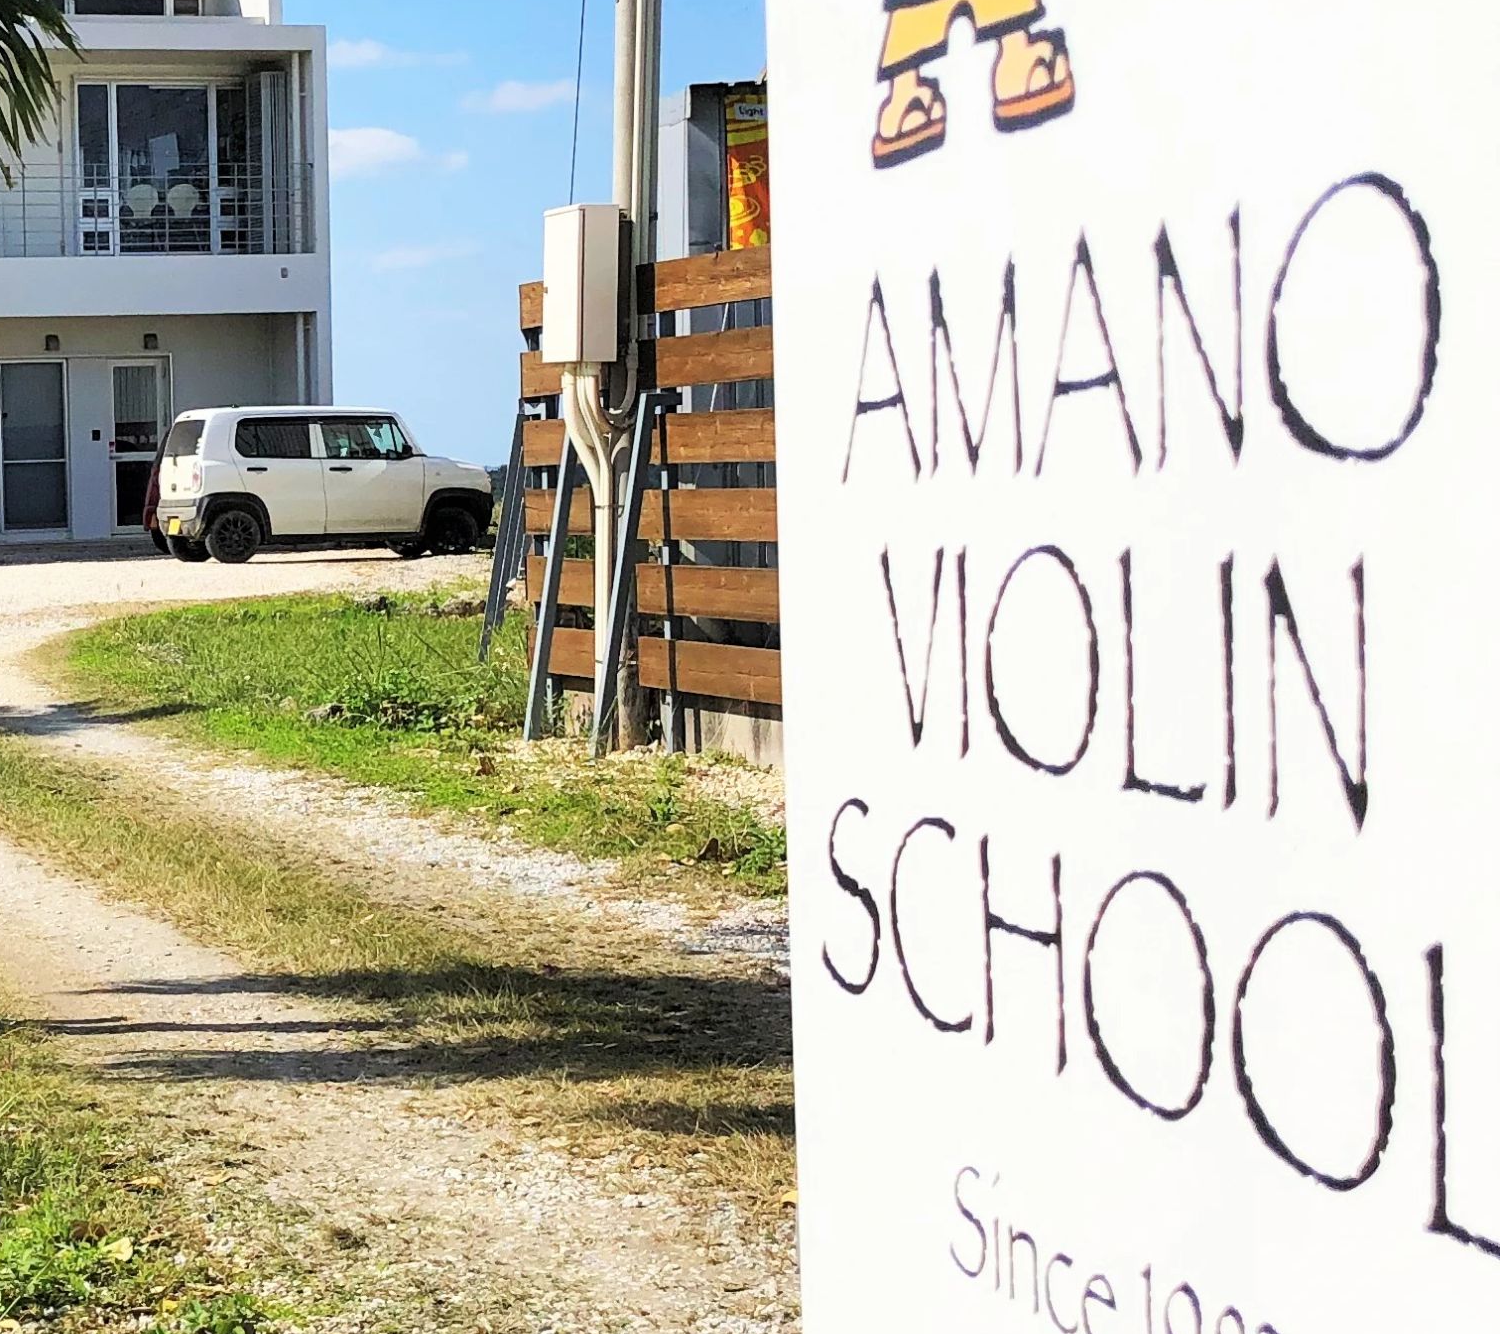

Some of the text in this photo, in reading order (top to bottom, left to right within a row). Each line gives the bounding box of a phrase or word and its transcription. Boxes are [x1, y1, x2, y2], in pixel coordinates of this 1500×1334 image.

[842, 170, 1443, 484] AMANO
[879, 544, 1370, 835] VIOLIN
[821, 797, 1500, 1261] SCHOOL
